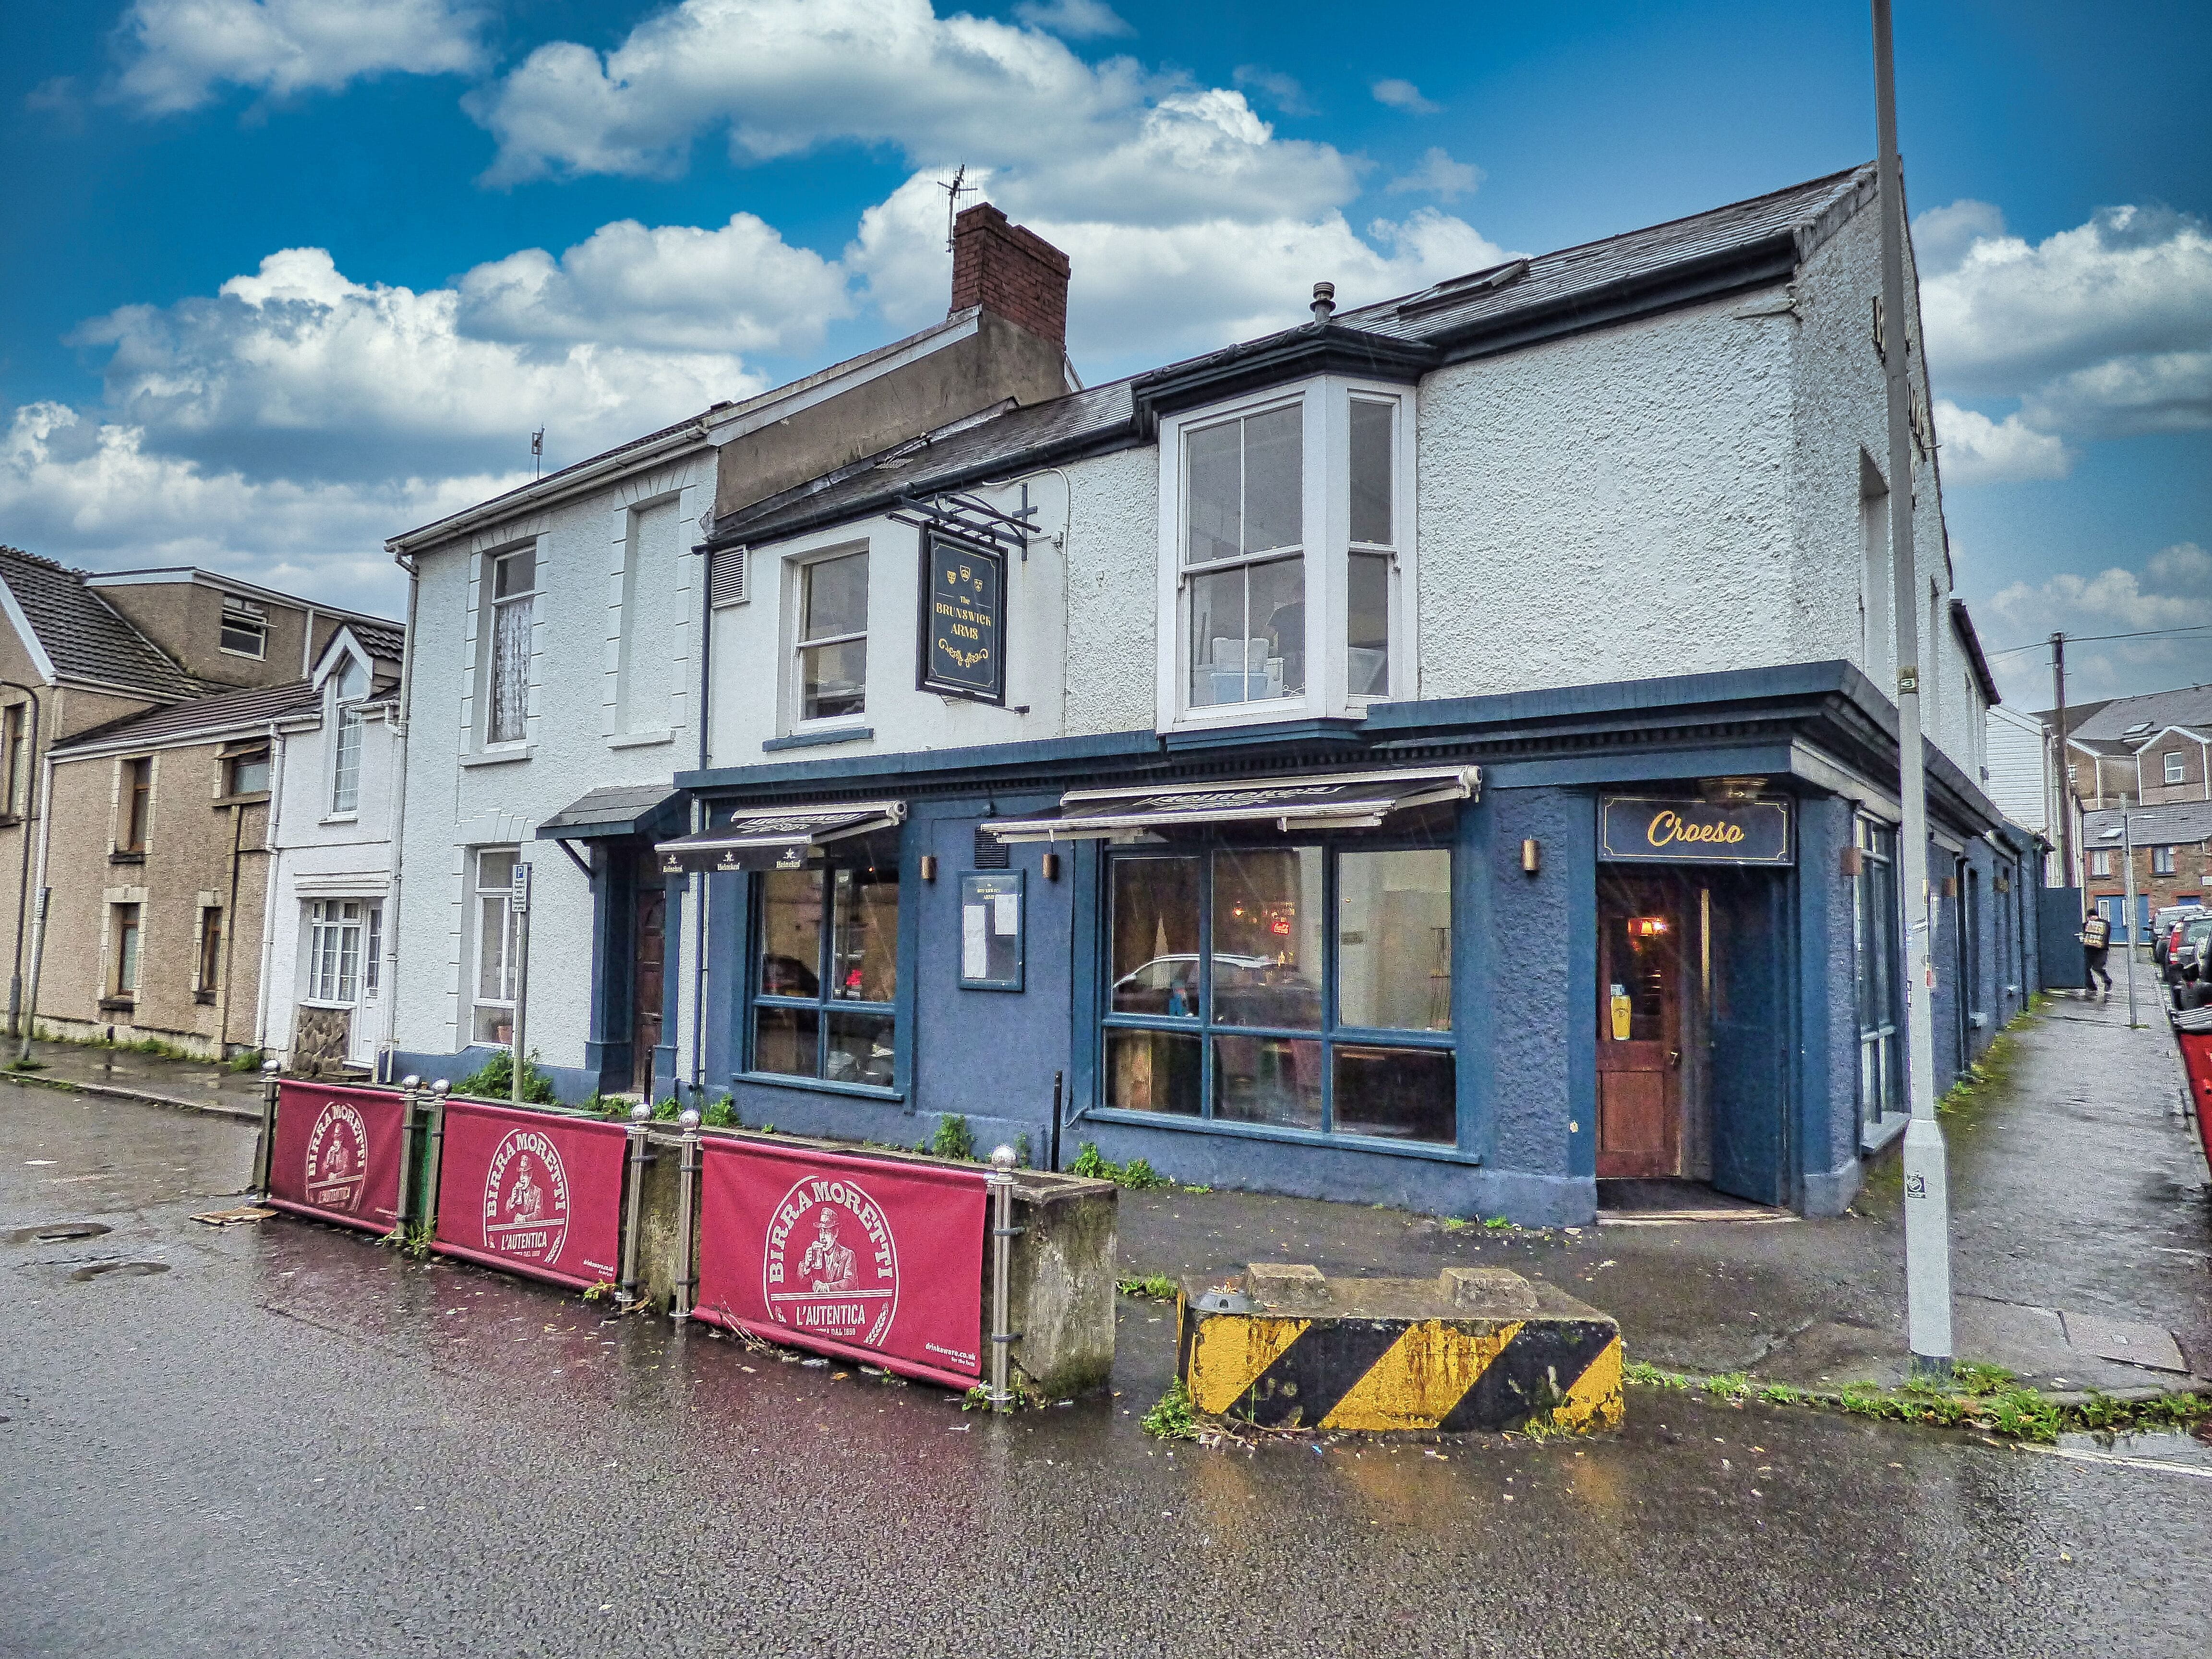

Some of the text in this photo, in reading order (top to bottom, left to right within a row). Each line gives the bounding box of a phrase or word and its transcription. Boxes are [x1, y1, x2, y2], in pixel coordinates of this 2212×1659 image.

[960, 596, 970, 605] The
[936, 602, 991, 627] BRUNSWICK
[950, 623, 978, 640] ARMS
[1647, 809, 1745, 847] Croeso
[717, 862, 740, 871] Heineken
[776, 859, 801, 869] Heineken
[486, 1133, 566, 1218] BIRRA MORETTI
[501, 1231, 547, 1251] L'AUTENTICA
[769, 1181, 893, 1283] BIRRA MORETTI
[796, 1304, 866, 1326] L'AUTENTICA
[925, 1342, 976, 1361] drinkaware.co.uk
